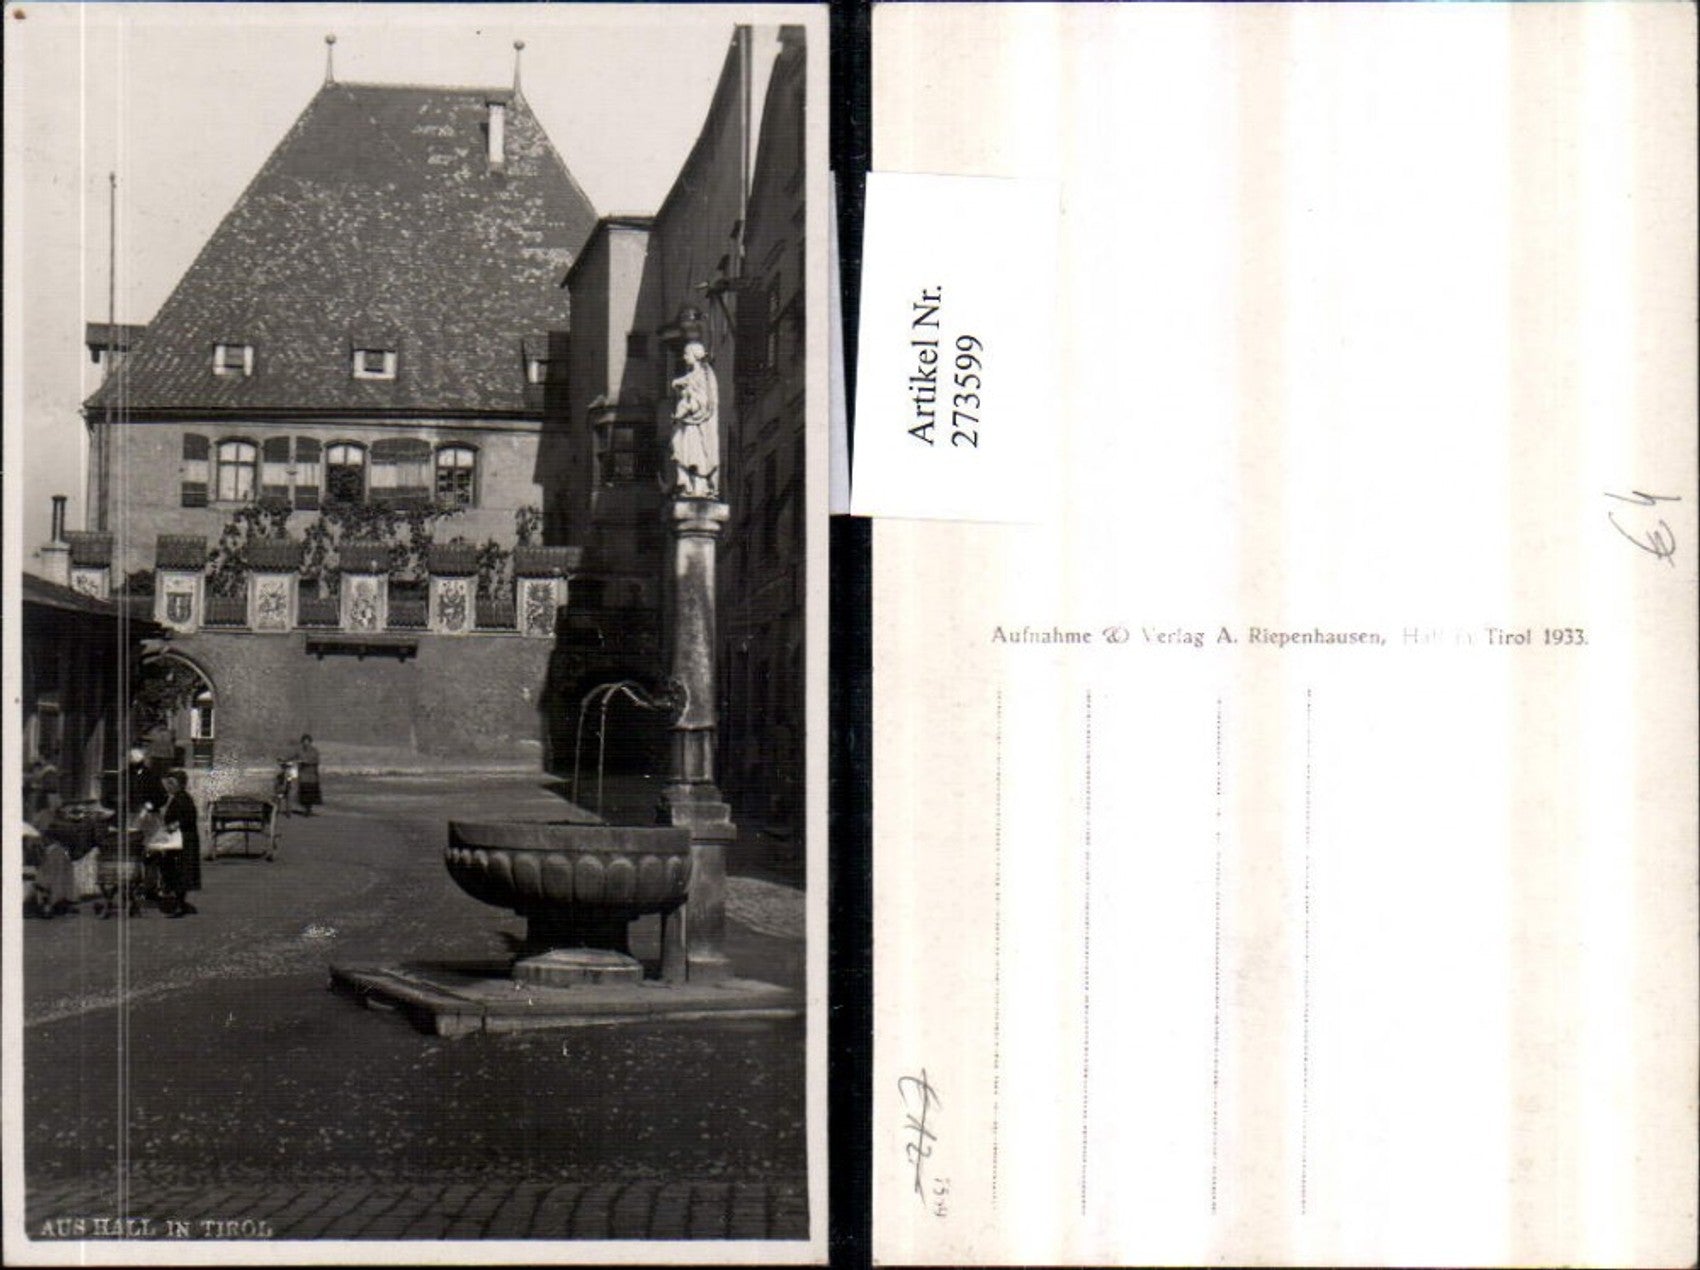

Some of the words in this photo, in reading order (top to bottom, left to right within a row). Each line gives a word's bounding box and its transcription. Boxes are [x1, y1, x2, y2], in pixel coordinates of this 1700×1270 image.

[911, 285, 942, 329] Nr.
[908, 341, 938, 446] Artikel
[951, 334, 984, 448] 273599
[991, 626, 1092, 645] Aufnahme
[1216, 626, 1238, 645] A.
[1248, 626, 1387, 648] Riepenhausen,
[1486, 627, 1531, 645] Tirol
[1543, 627, 1589, 645] 1933.
